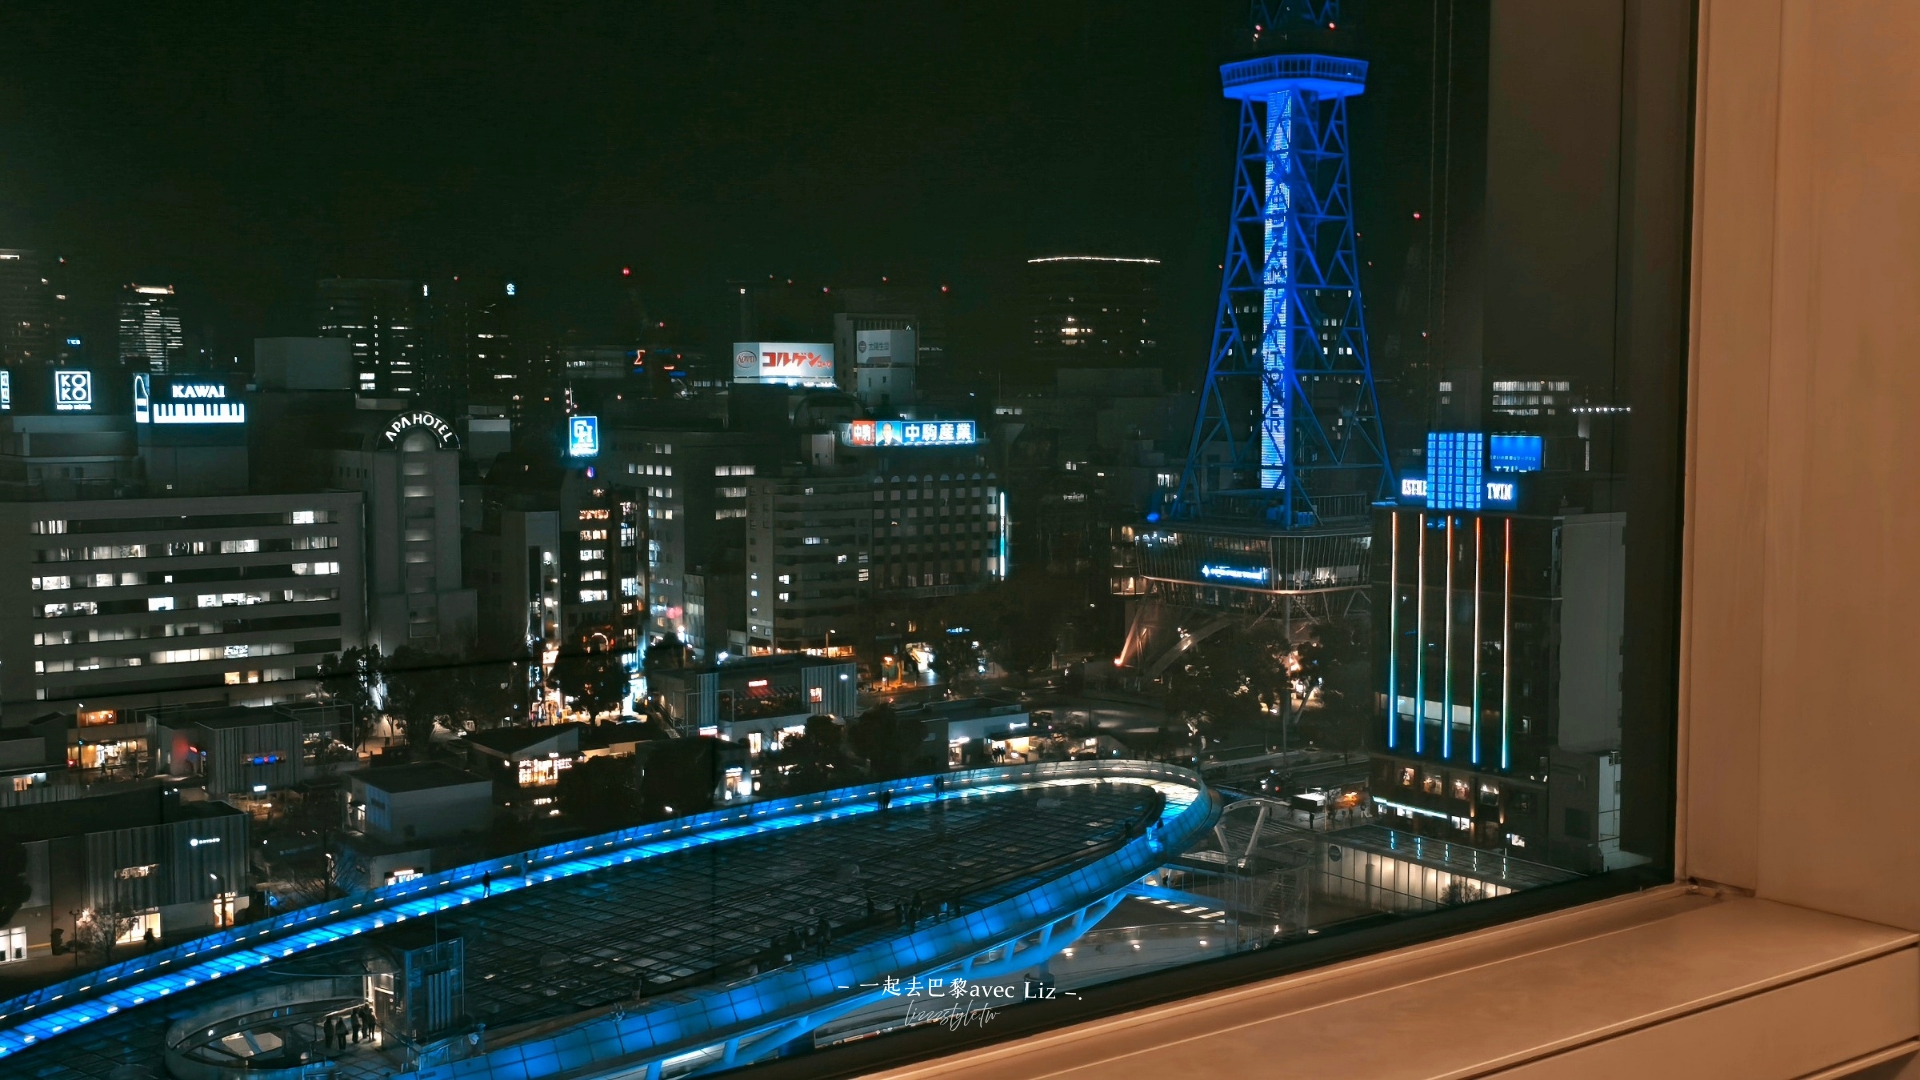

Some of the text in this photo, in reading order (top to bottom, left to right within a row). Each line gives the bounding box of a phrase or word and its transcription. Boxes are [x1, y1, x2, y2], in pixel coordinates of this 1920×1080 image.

[172, 385, 226, 399] KAWAI
[385, 413, 453, 443] APA HOTEL
[904, 423, 972, 442] 中駒産業
